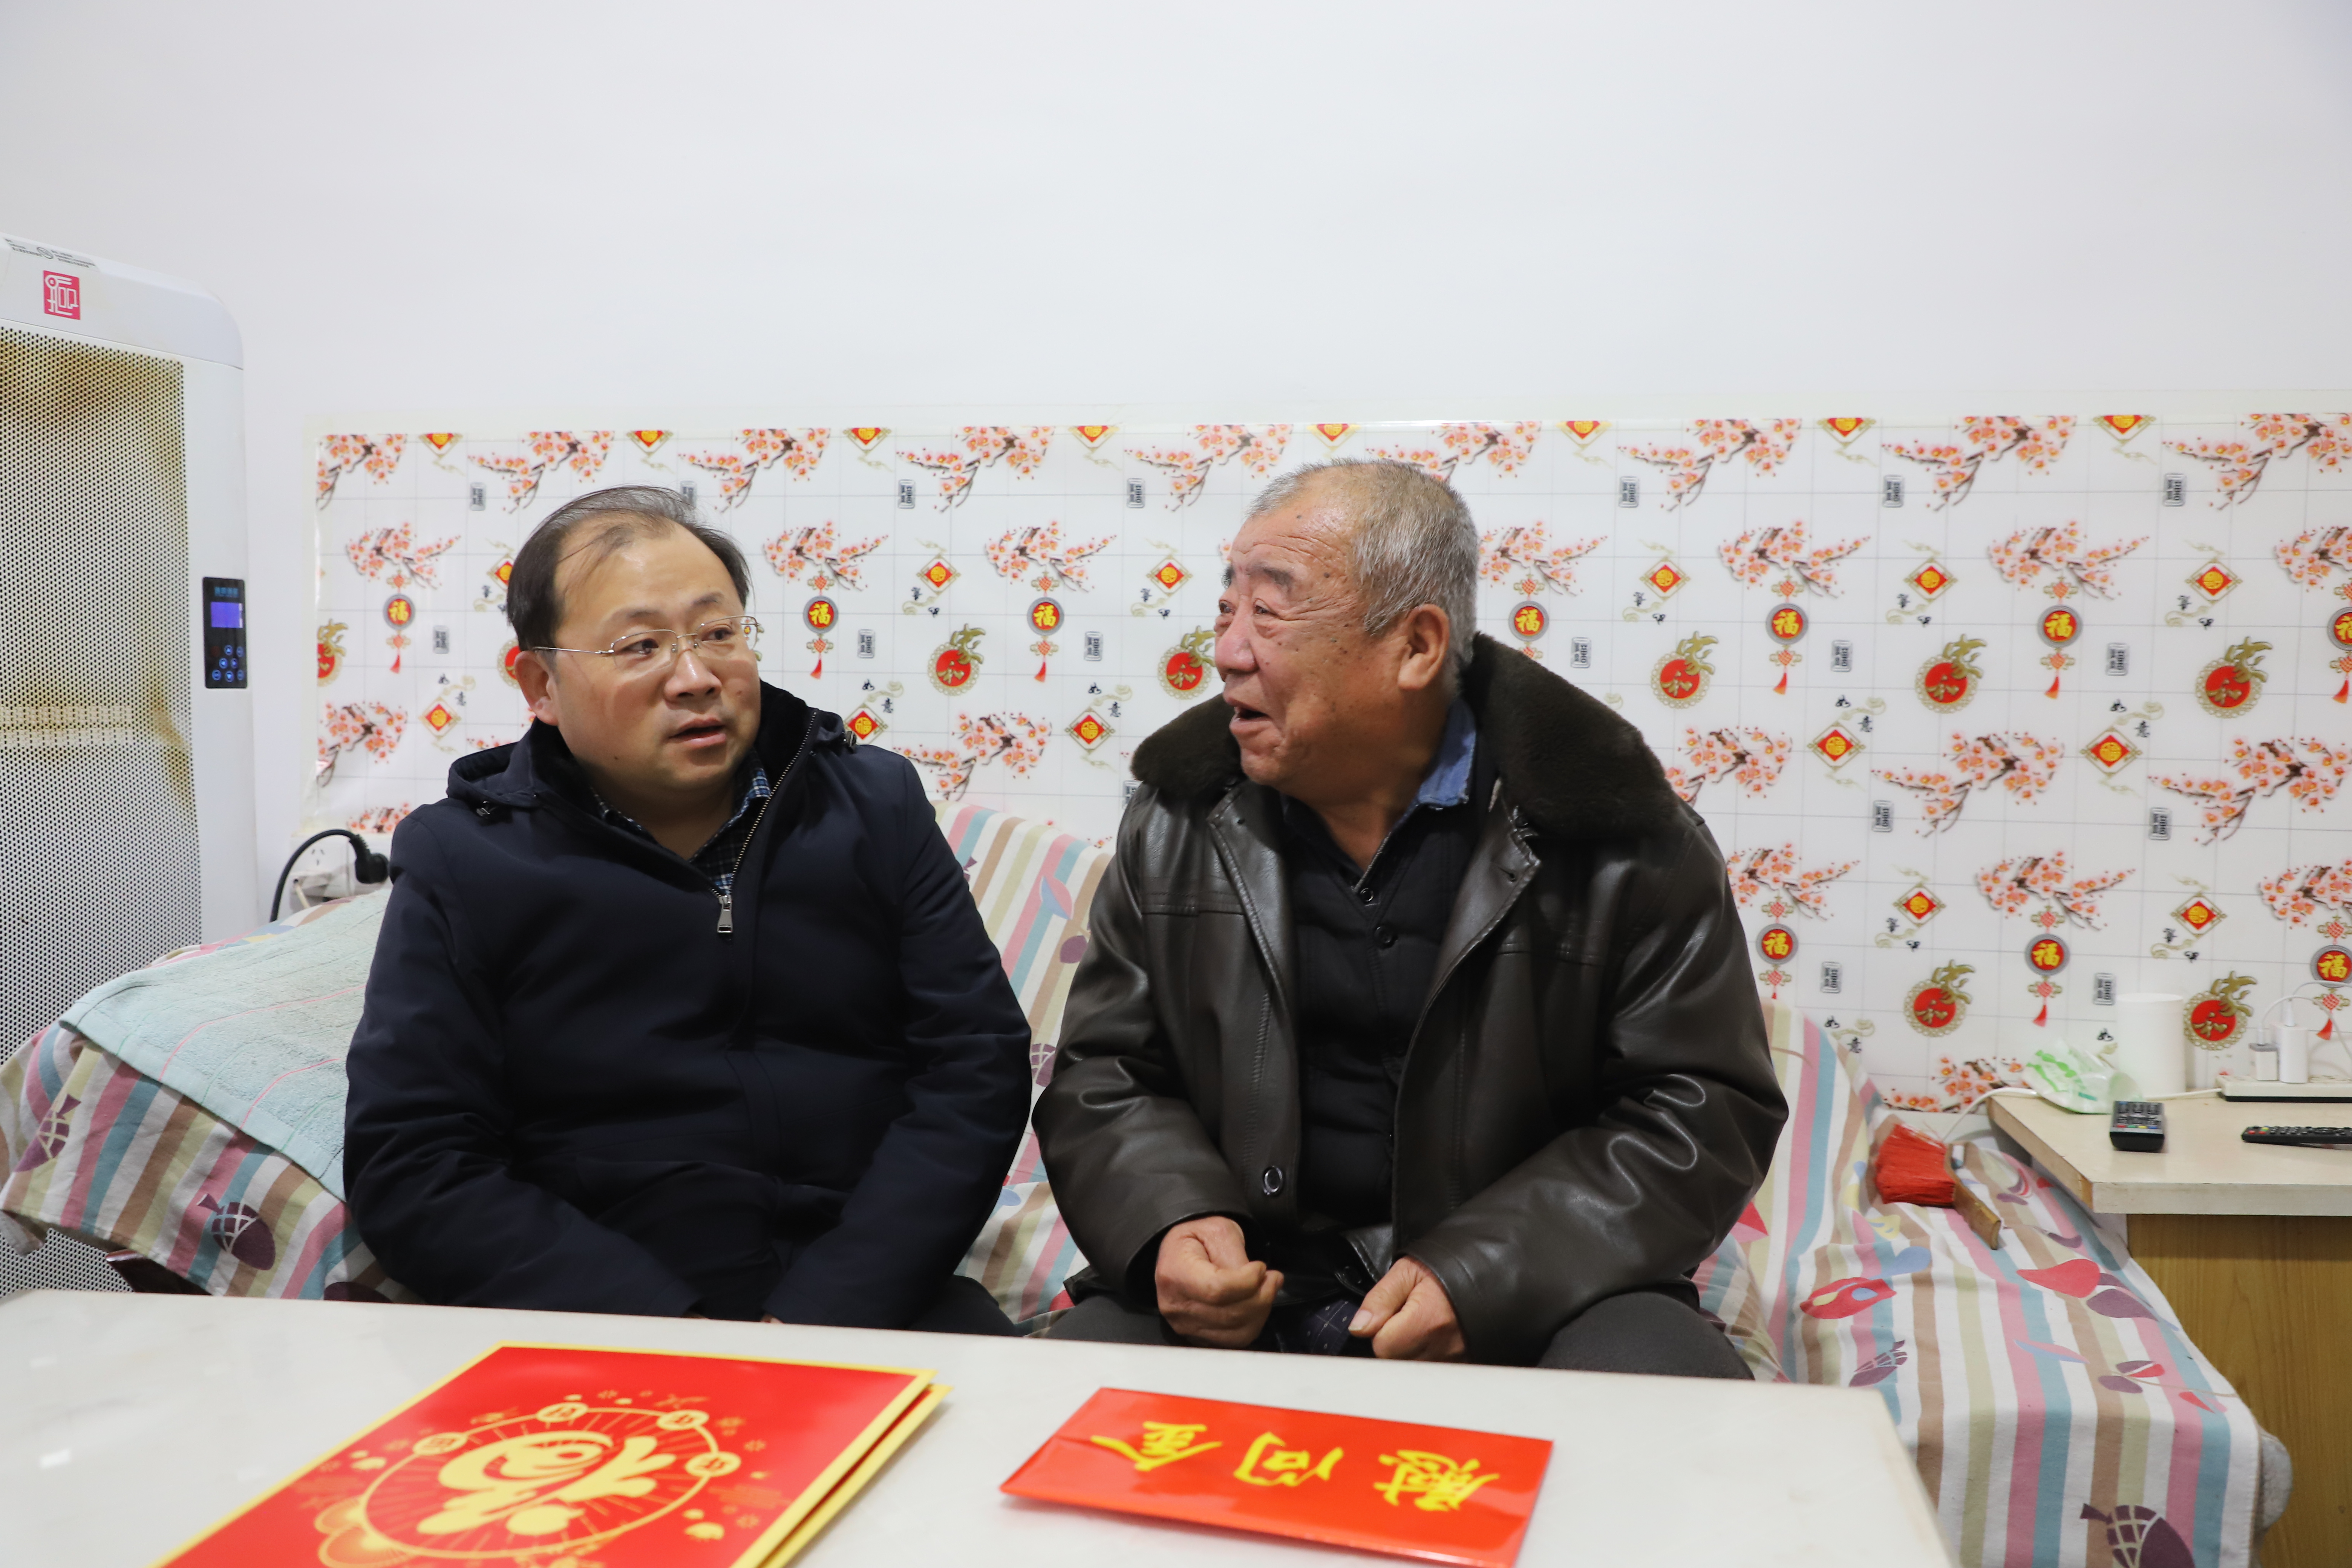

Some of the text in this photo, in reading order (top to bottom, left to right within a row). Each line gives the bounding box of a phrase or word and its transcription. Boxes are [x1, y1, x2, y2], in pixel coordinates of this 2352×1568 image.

[389, 600, 409, 622] 福
[808, 603, 831, 625] 福
[1033, 604, 1057, 627] 福
[1515, 608, 1541, 634] 福
[1773, 611, 1800, 639] 福
[2044, 613, 2073, 643] 福
[1762, 932, 1790, 956] 福
[2032, 942, 2061, 967] 福
[2318, 954, 2348, 978] 福
[1091, 1421, 1499, 1511] 慰问金
